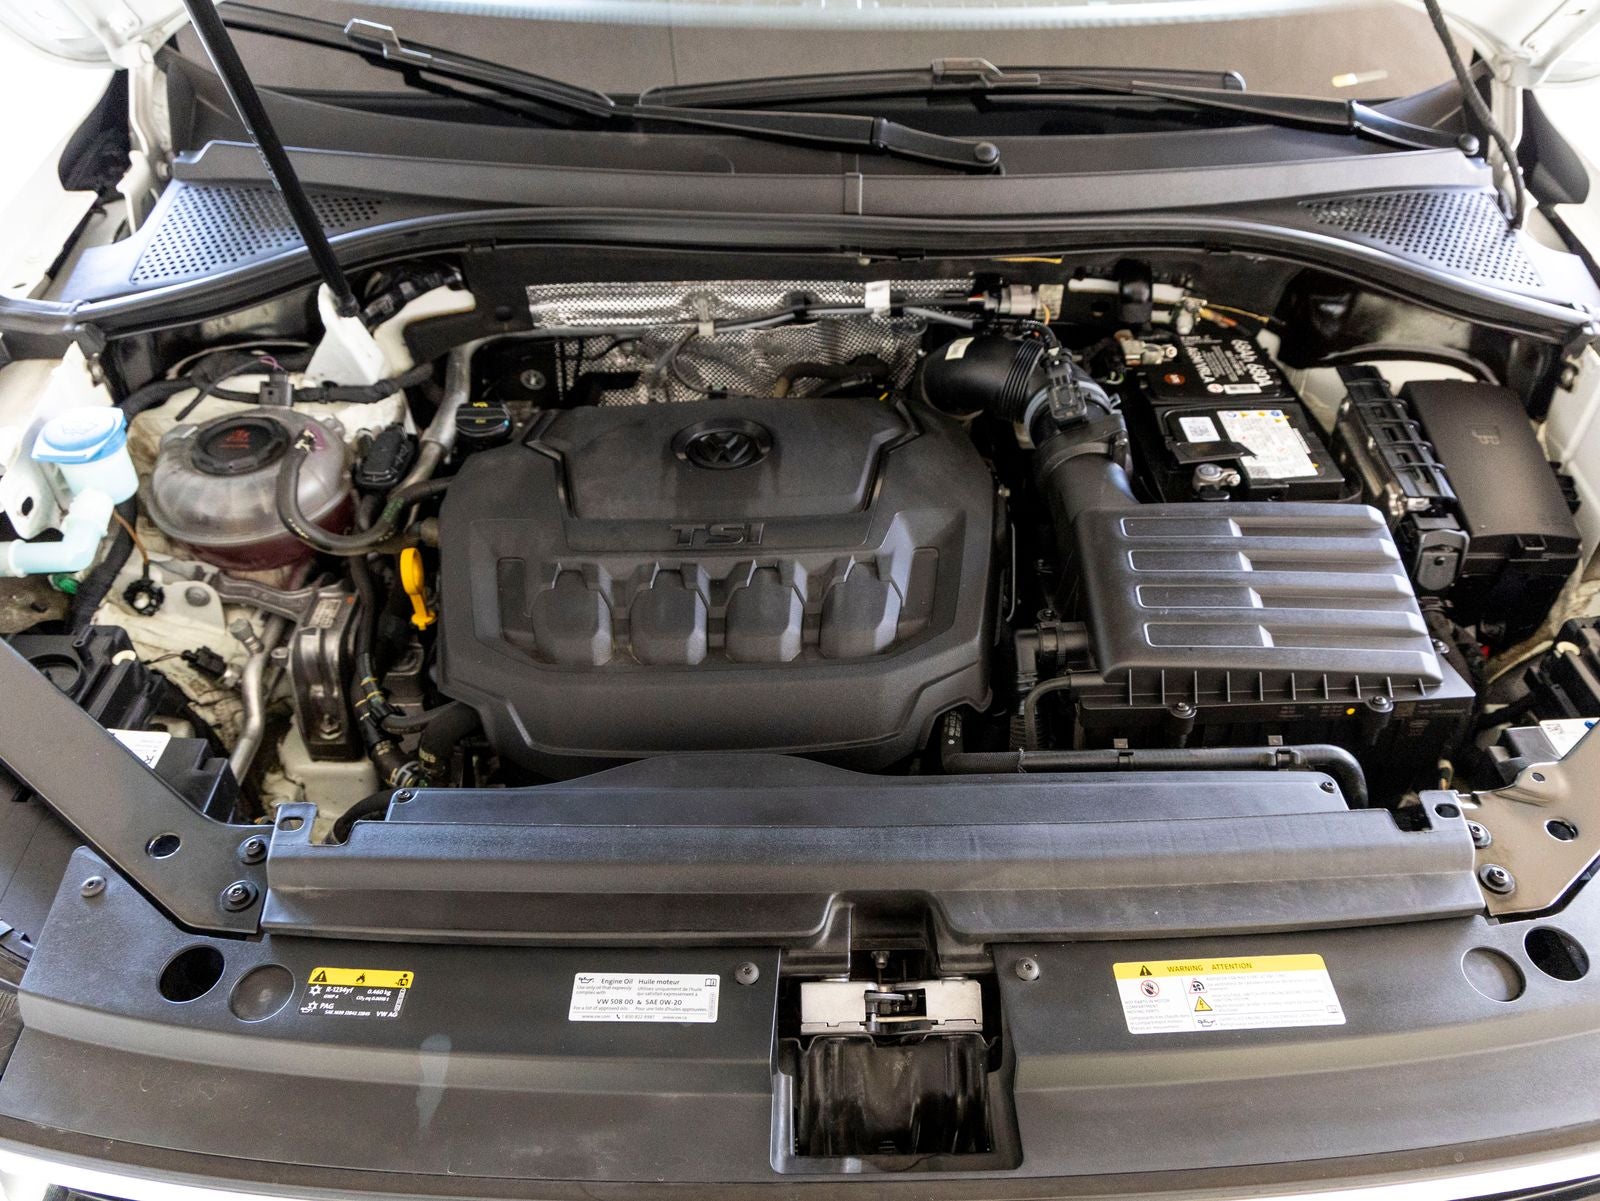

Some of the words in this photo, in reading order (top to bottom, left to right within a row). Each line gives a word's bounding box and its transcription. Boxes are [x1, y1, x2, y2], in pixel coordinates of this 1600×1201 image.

[669, 521, 765, 547] TSI
[1166, 964, 1204, 973] WARNING
[1211, 962, 1253, 970] ATTENTION
[601, 978, 623, 986] Engine
[325, 986, 355, 995] R-1234yf
